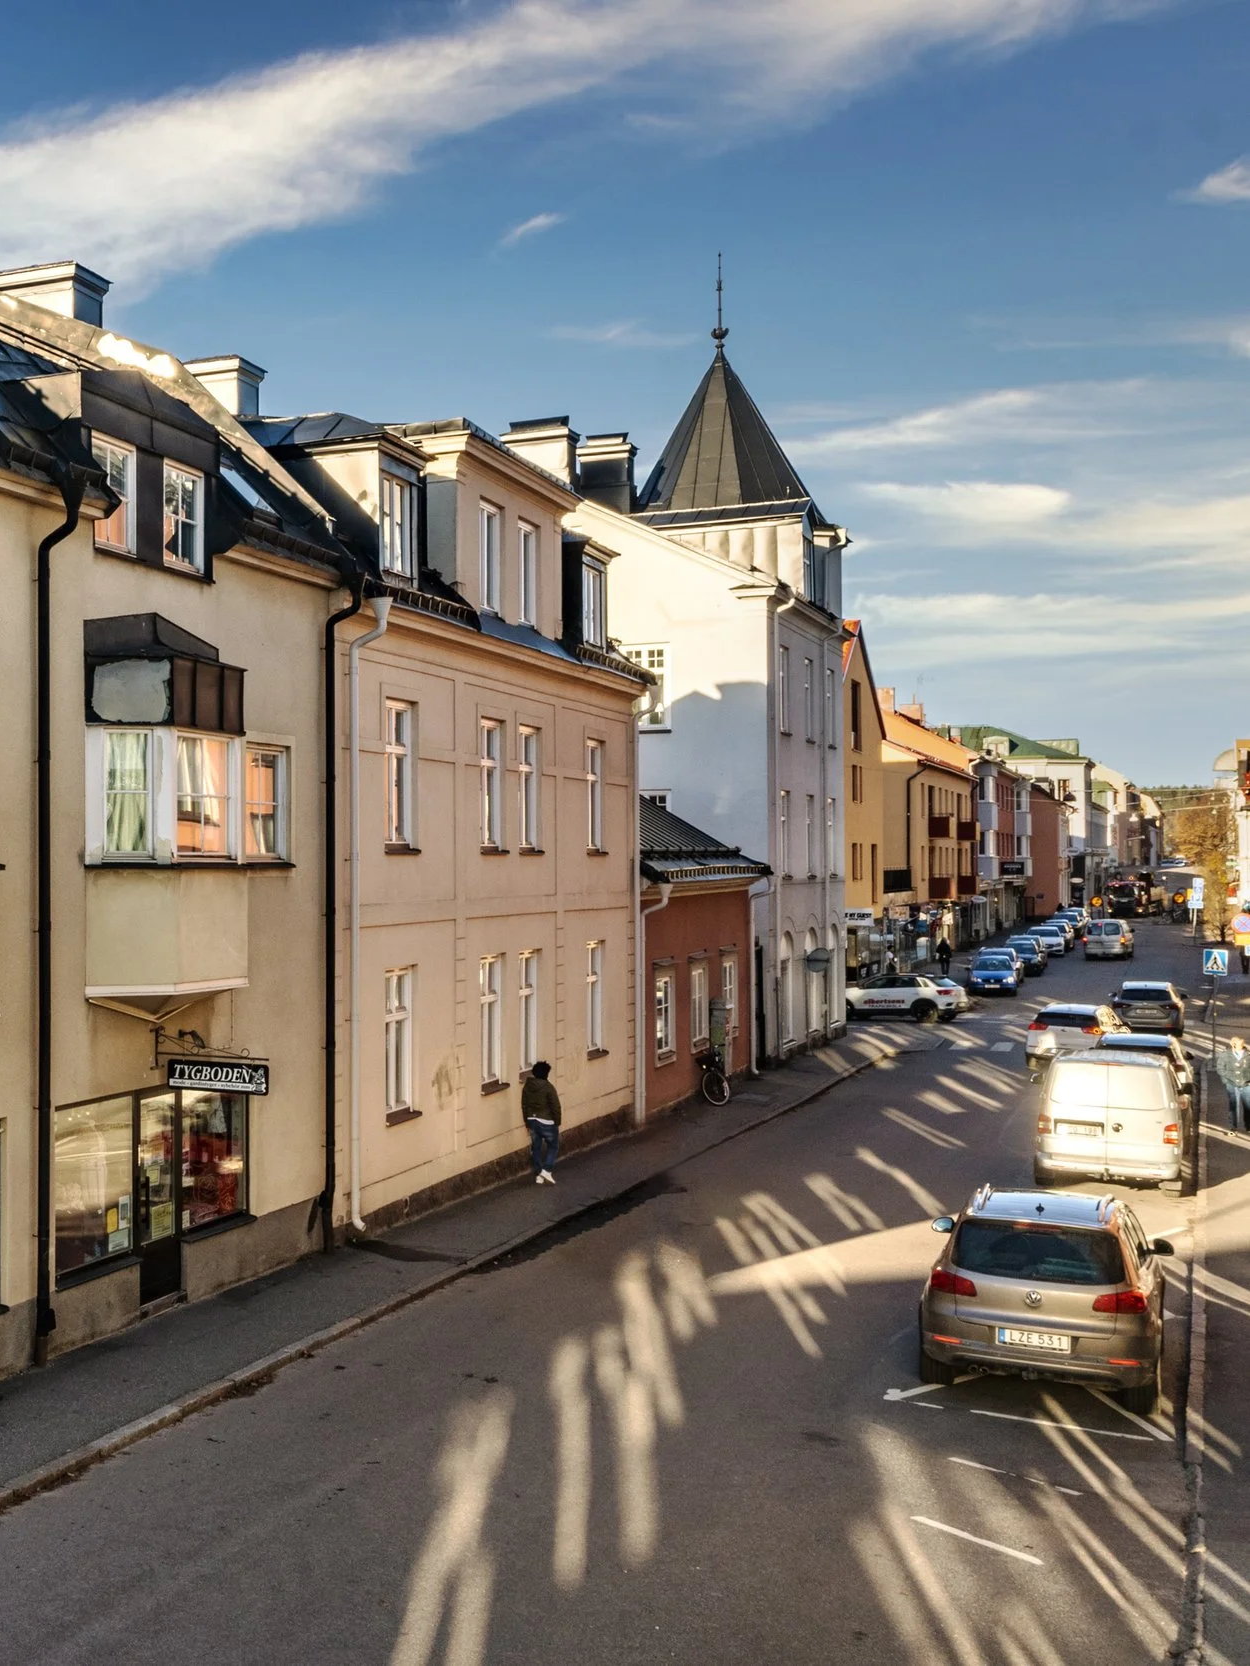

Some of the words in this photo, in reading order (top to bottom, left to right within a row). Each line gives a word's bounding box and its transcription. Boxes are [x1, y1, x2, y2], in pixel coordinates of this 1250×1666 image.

[174, 1064, 251, 1083] TYGBODEN
[1010, 1331, 1033, 1344] LZE
[1038, 1335, 1062, 1347] 531
